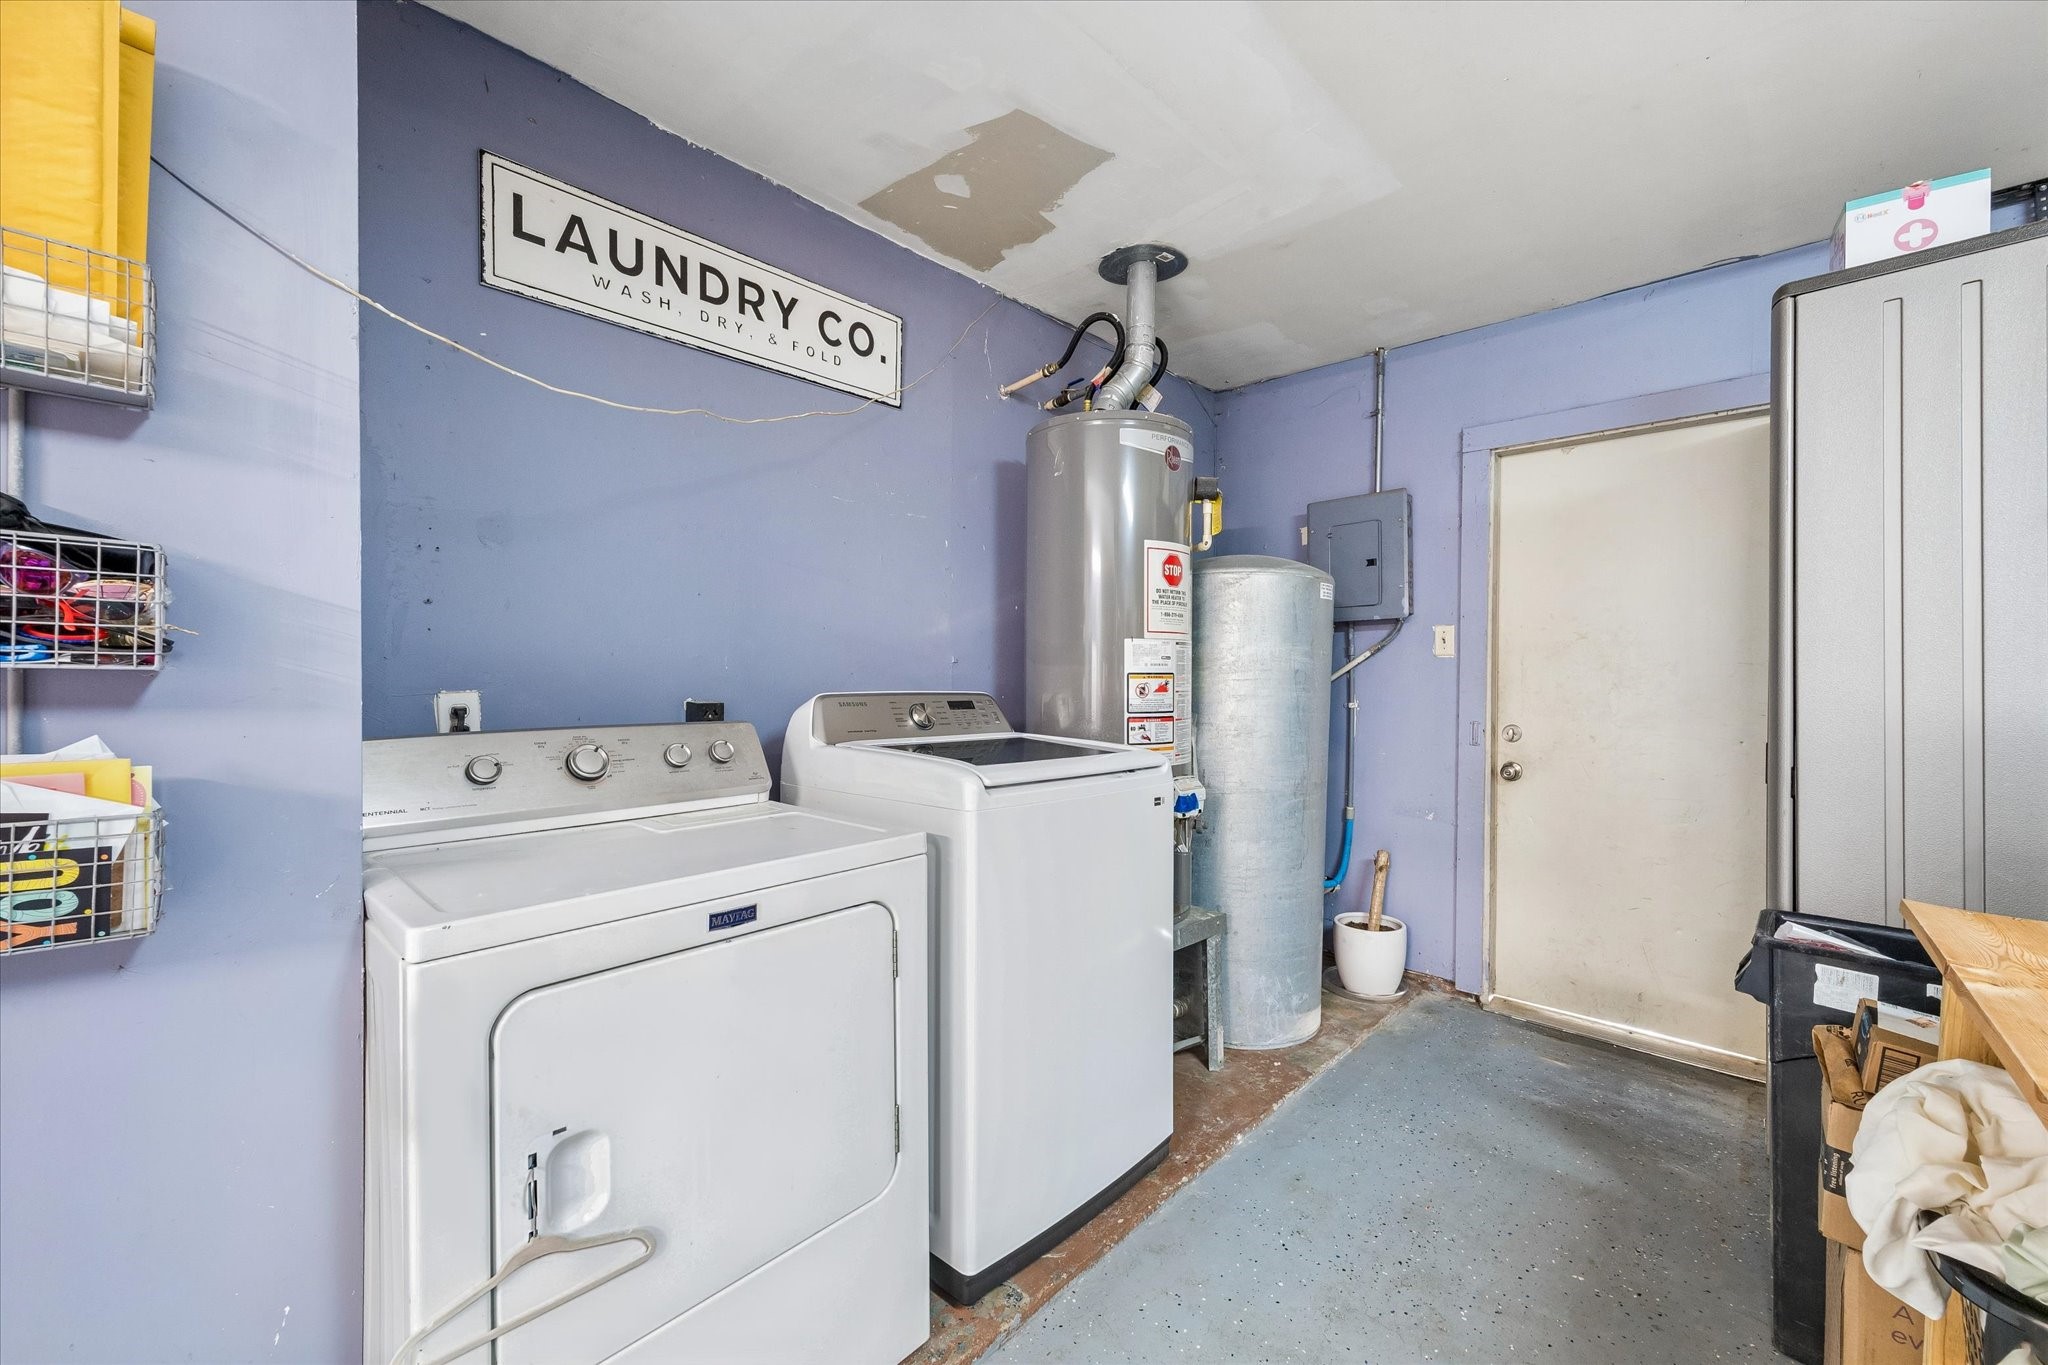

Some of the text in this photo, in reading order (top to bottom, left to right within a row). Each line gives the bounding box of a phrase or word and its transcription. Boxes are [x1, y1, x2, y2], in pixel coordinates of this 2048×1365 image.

[512, 191, 887, 365] LAUNDRY CO.
[592, 274, 841, 367] WASH, DRY, & FOLD
[1164, 564, 1182, 577] STOP
[362, 808, 408, 817] ENTENNIAL
[711, 908, 755, 927] MAYTAG
[1829, 1152, 1841, 1189] free listening
[1892, 1305, 1914, 1326] A
